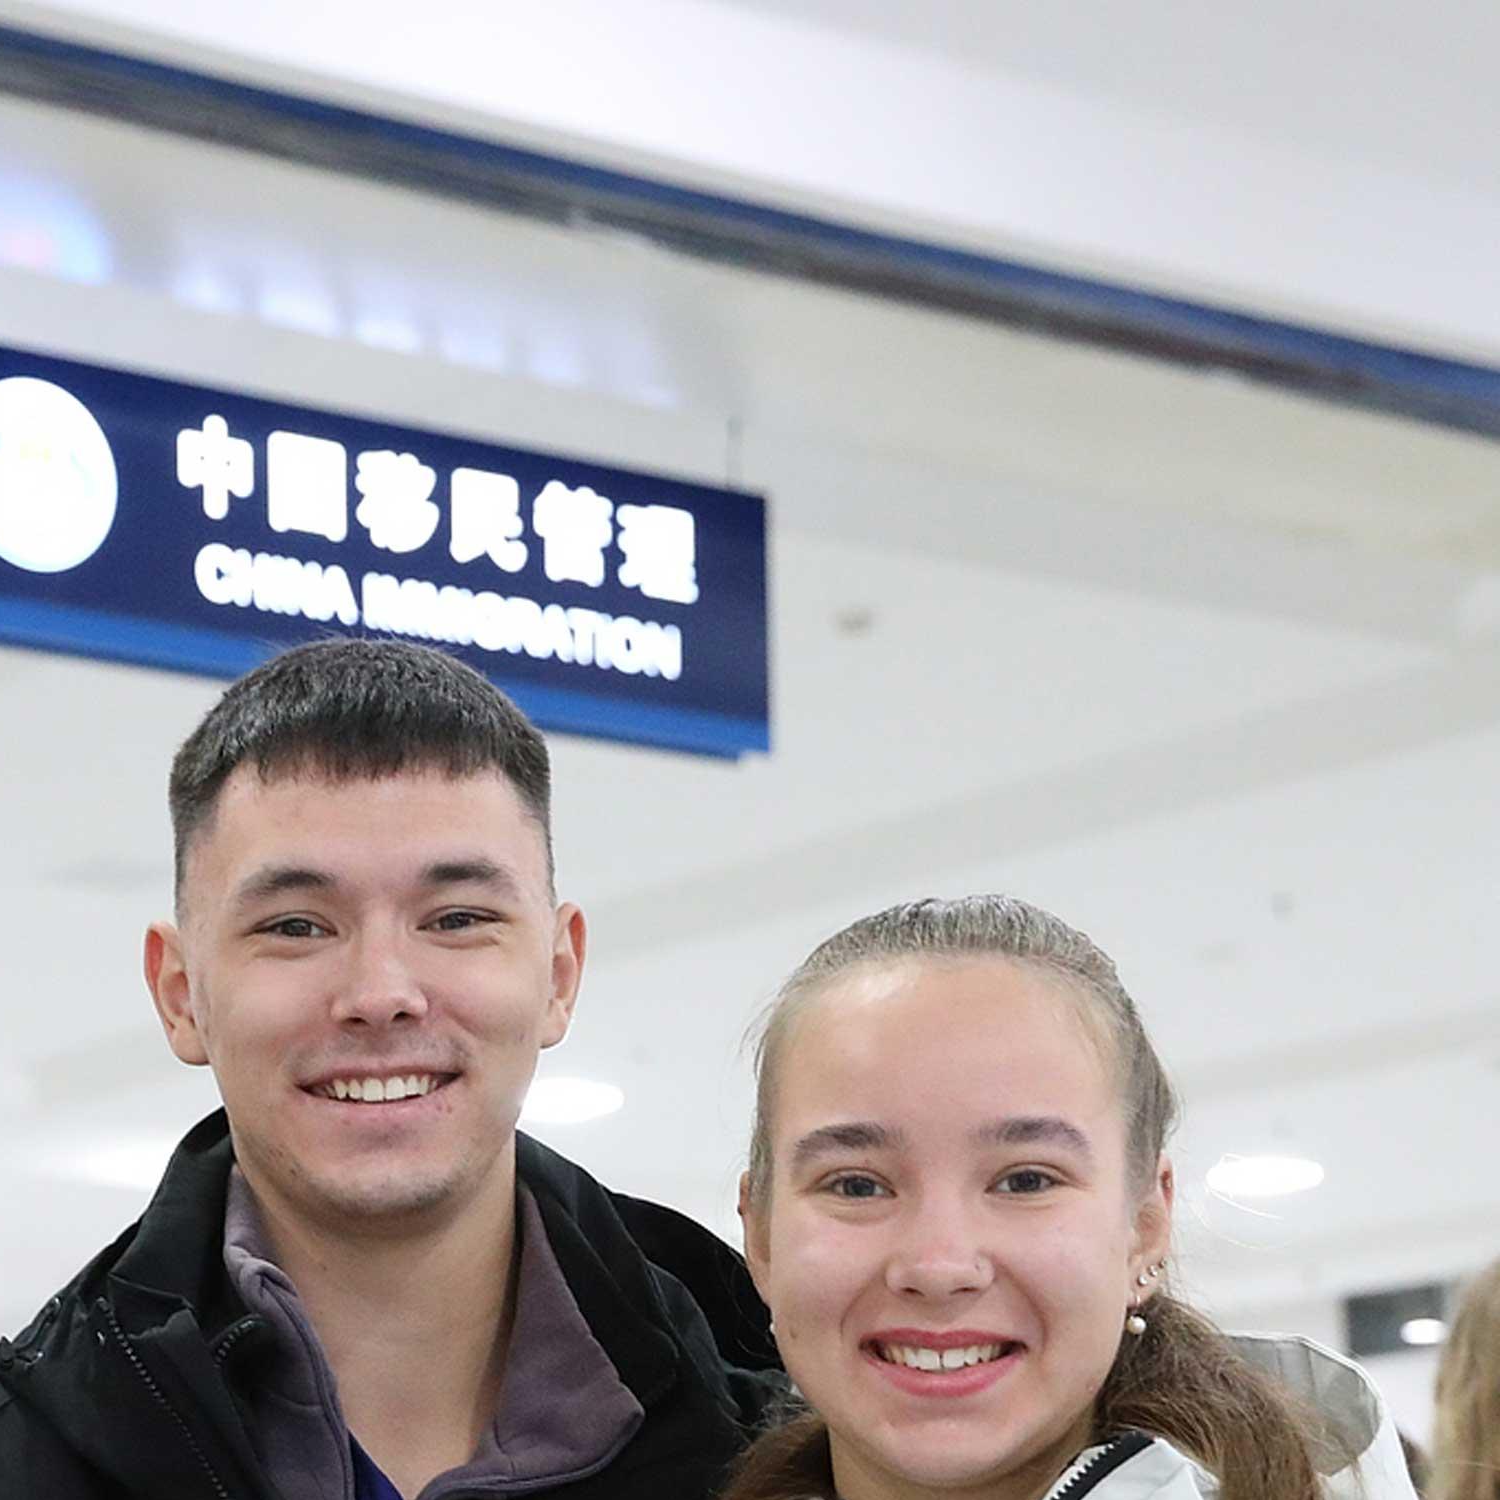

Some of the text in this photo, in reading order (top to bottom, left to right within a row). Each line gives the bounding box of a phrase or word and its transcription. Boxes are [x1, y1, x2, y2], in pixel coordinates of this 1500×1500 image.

[176, 415, 698, 604] 中国移民管理
[194, 543, 682, 680] CHINA IMMIGRATION
